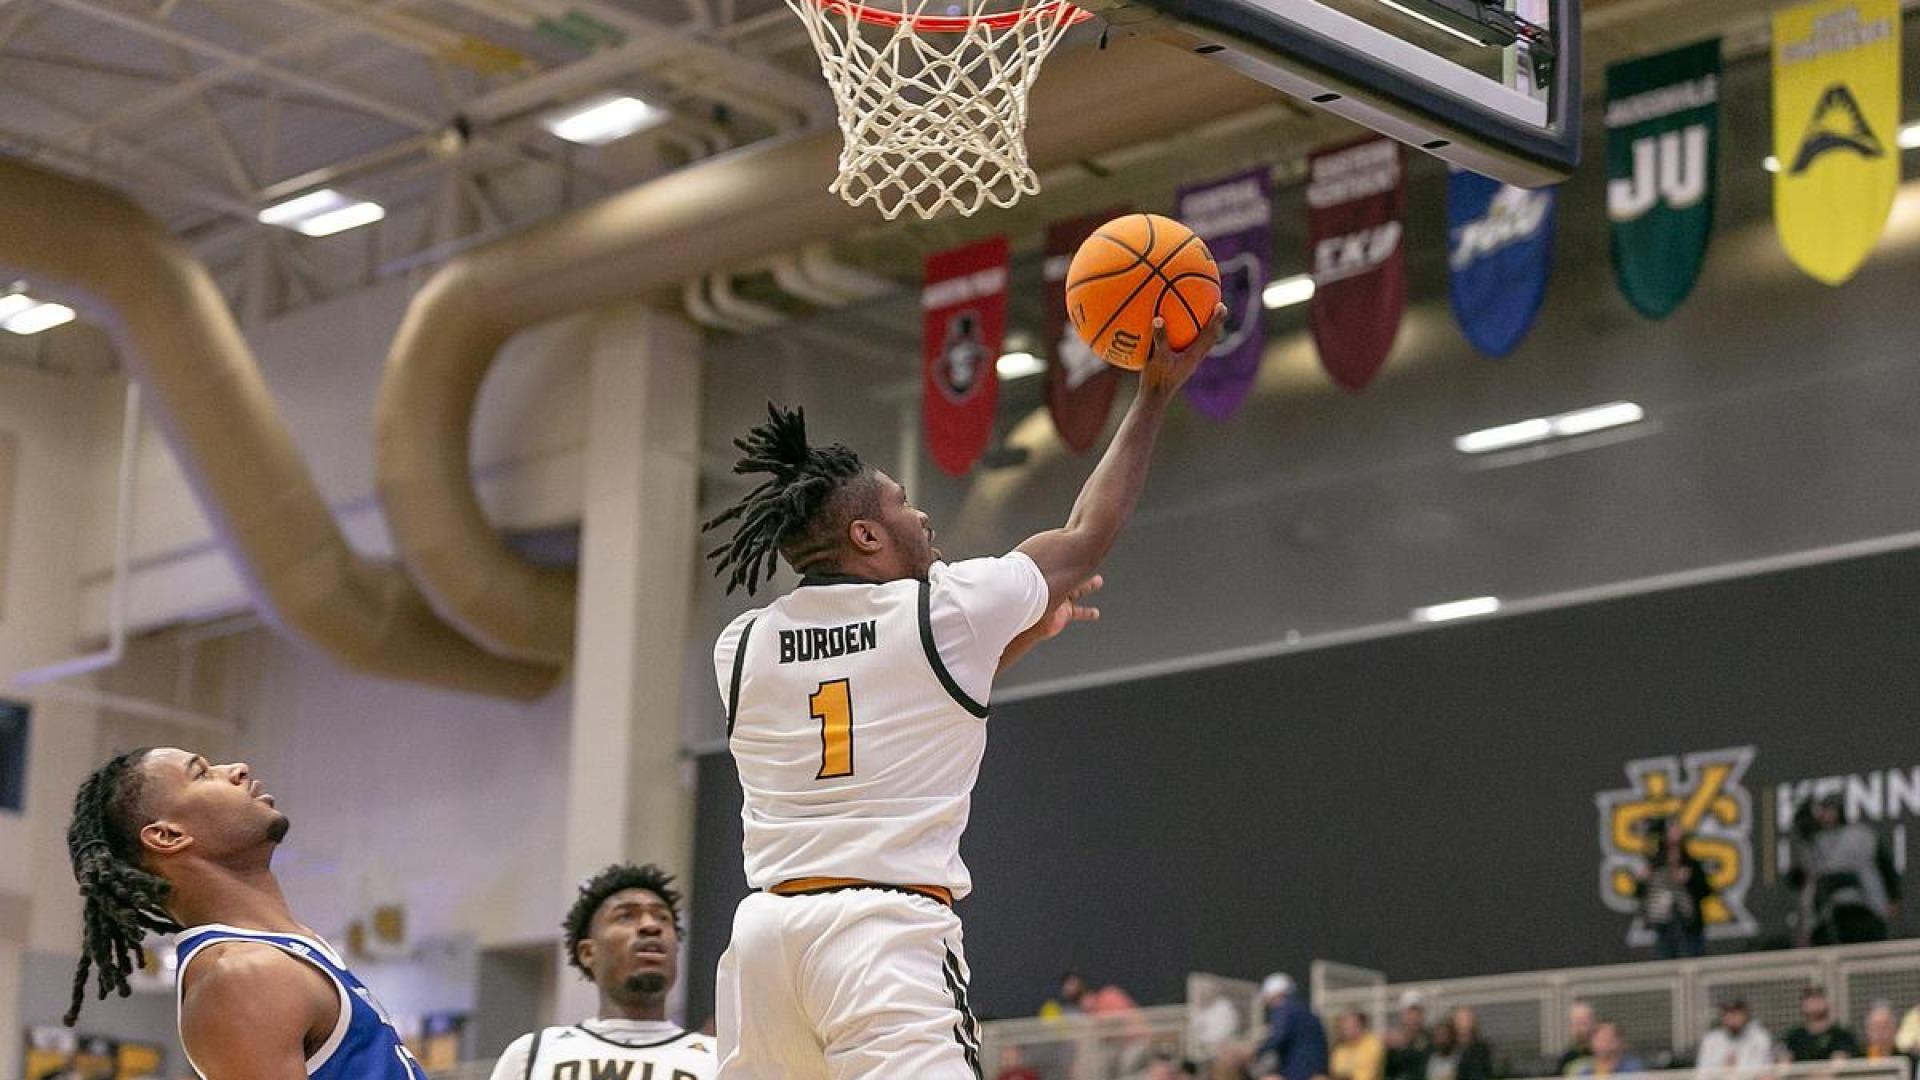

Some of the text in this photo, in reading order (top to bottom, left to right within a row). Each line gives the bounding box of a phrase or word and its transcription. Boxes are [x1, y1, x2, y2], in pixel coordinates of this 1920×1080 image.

[1606, 123, 1709, 222] JU
[778, 620, 877, 664] BURDEN
[808, 677, 854, 780] 1
